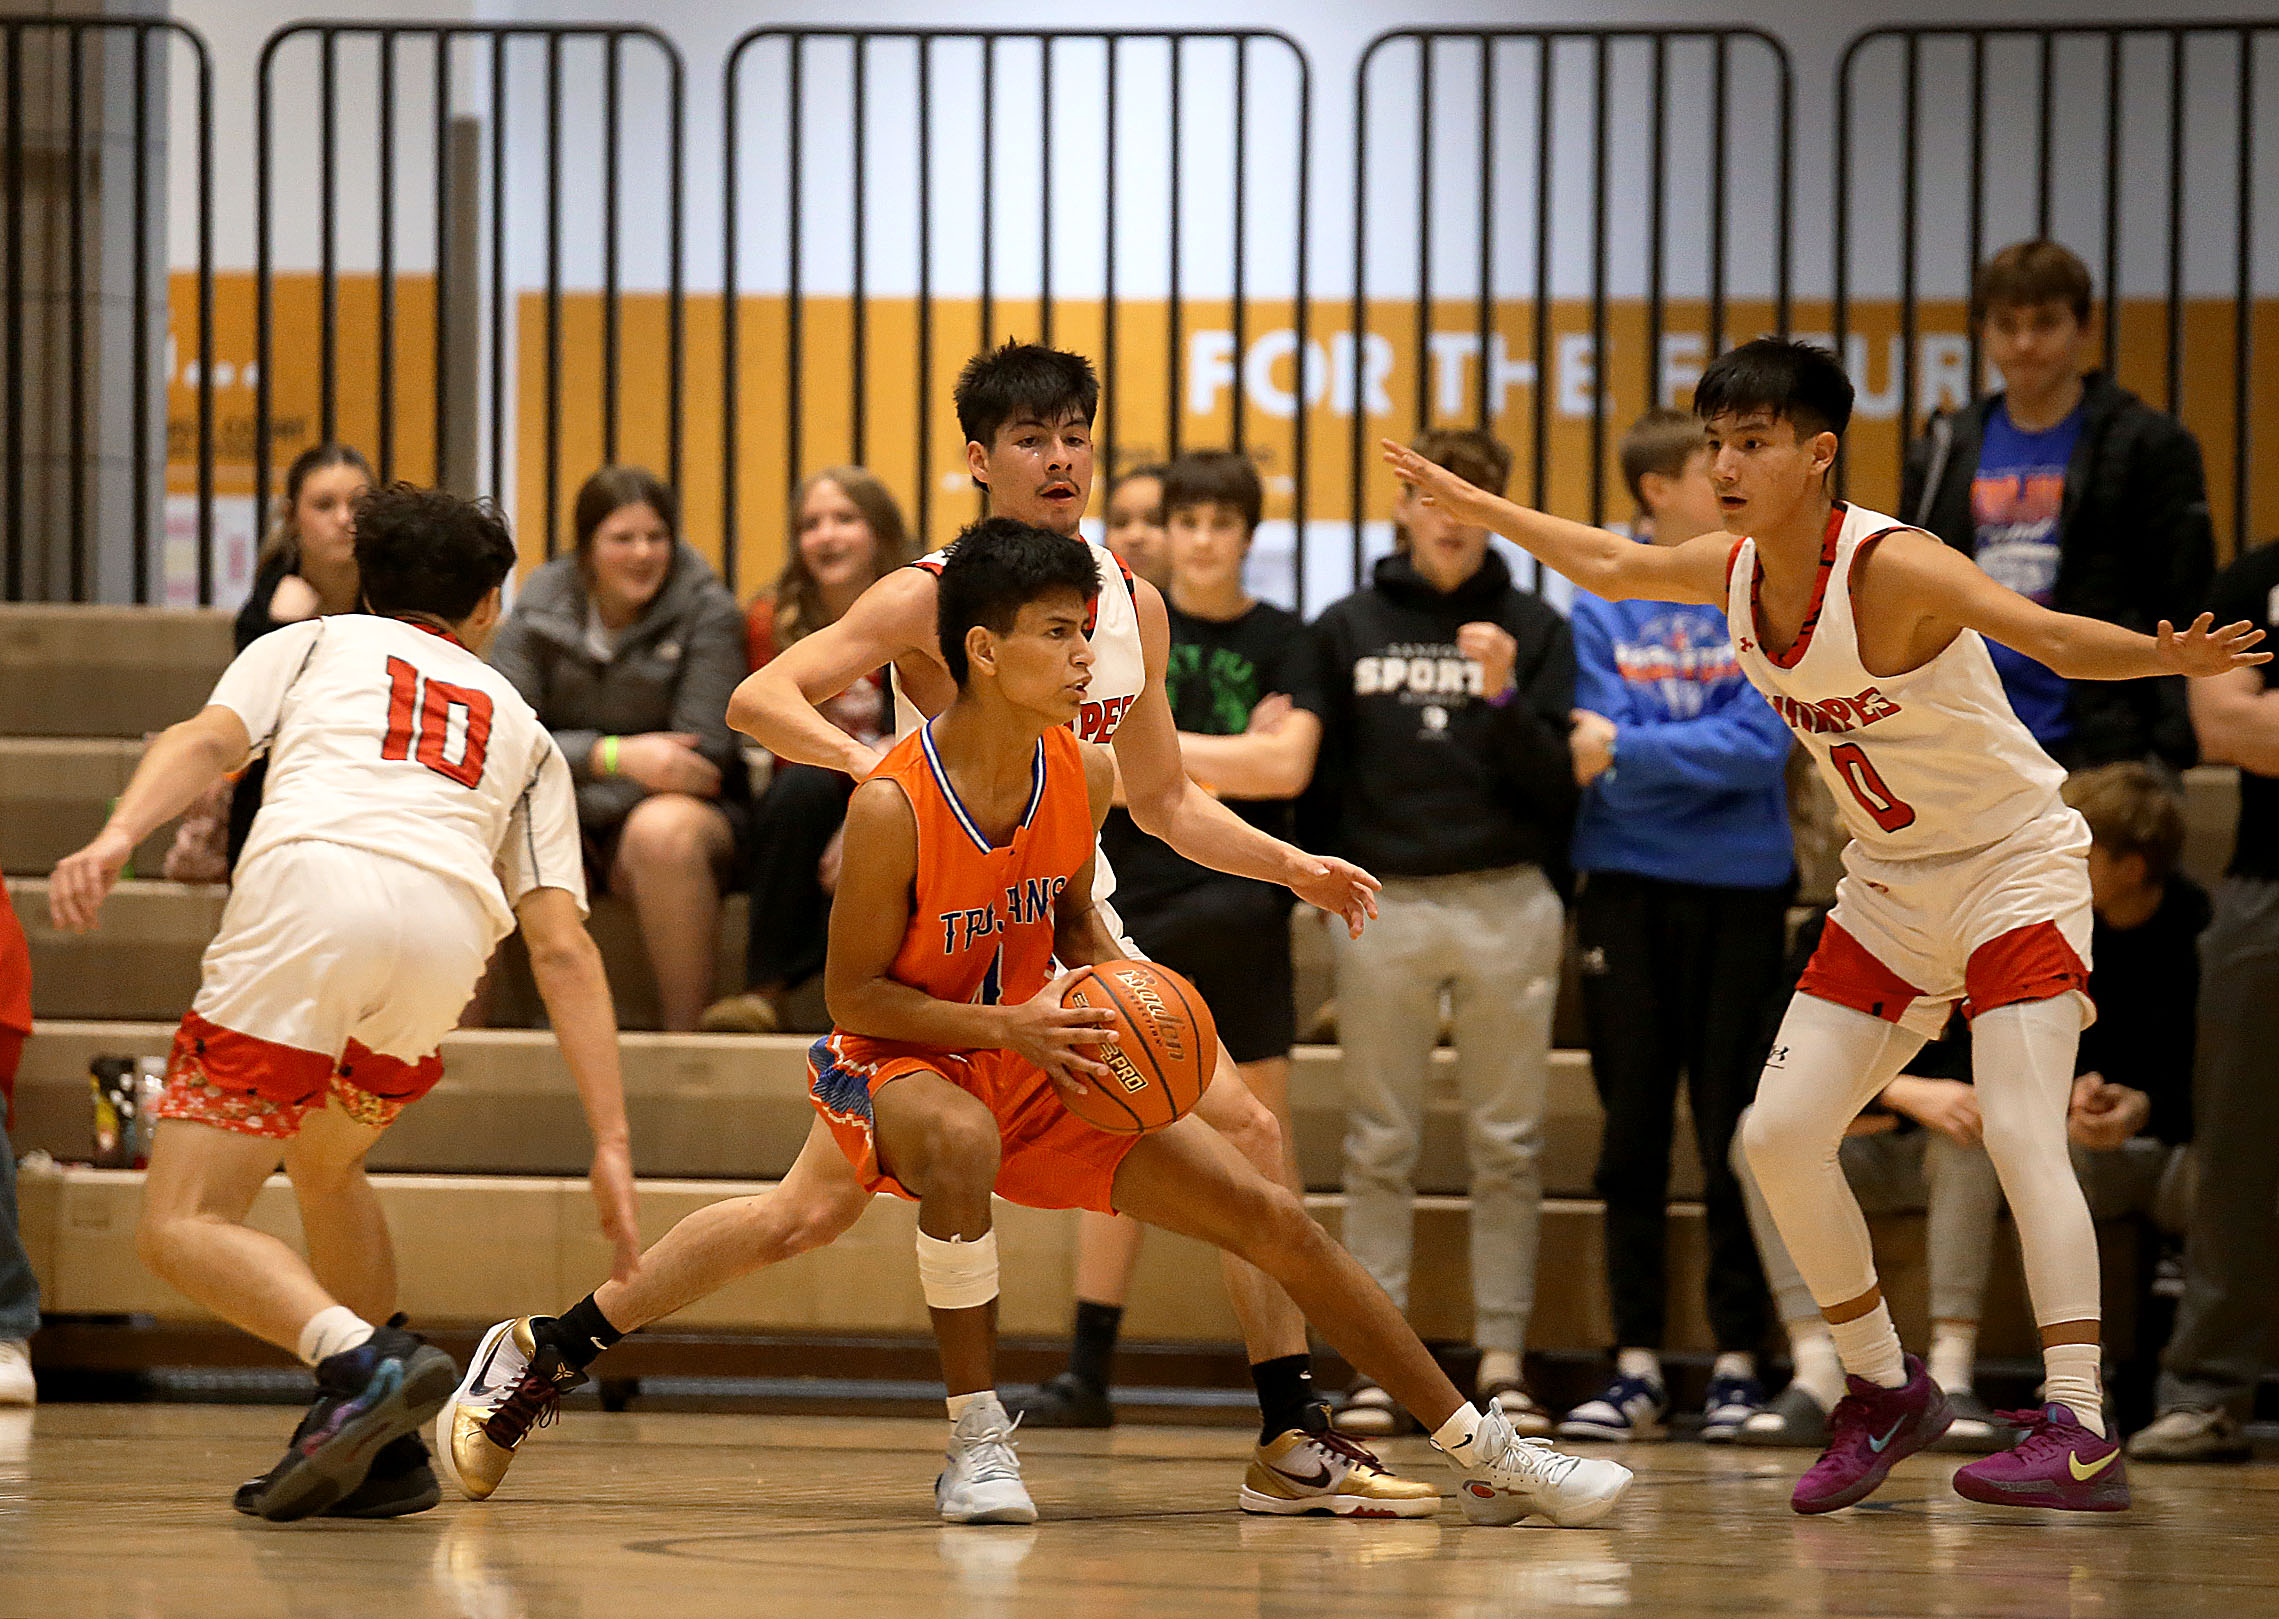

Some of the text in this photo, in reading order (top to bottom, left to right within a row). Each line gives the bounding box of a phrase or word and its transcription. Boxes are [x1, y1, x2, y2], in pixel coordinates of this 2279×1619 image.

[1187, 329, 1395, 417] FOR
[1425, 330, 1614, 417] THE
[1353, 657, 1484, 696] SPORT
[380, 654, 494, 790] 10
[1829, 742, 1916, 833] 0
[1109, 1055, 1145, 1091] PRO
